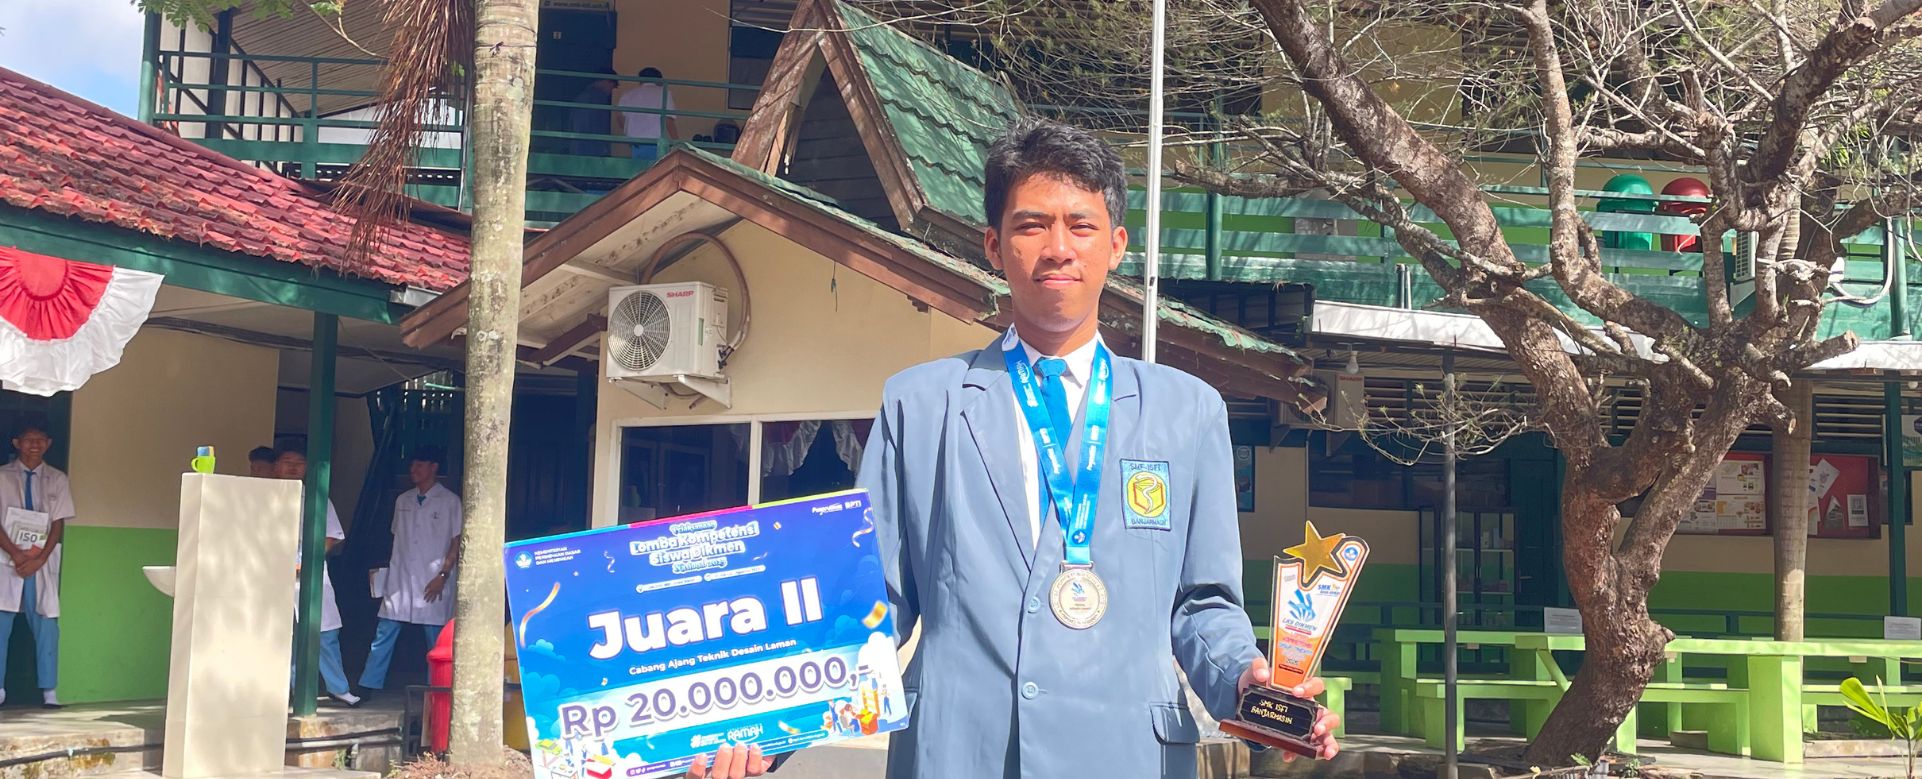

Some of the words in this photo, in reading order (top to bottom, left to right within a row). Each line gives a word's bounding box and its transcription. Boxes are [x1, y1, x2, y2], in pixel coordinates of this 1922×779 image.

[666, 290, 694, 298] SHARP
[20, 532, 38, 543] ISO
[631, 536, 678, 555] Lomba
[680, 521, 758, 546] Kompetensi
[650, 548, 690, 565] Siswa
[690, 541, 744, 560] Dikmen
[588, 596, 768, 660] Juara
[780, 576, 823, 627] II
[628, 662, 666, 676] Cabang
[668, 656, 696, 670] Ajang
[697, 650, 729, 663] Teknik
[731, 645, 764, 657] Desain
[765, 639, 797, 651] Laman
[562, 704, 618, 737] Rp
[626, 656, 869, 723] 20.000.000,-
[1259, 699, 1274, 709] SMK
